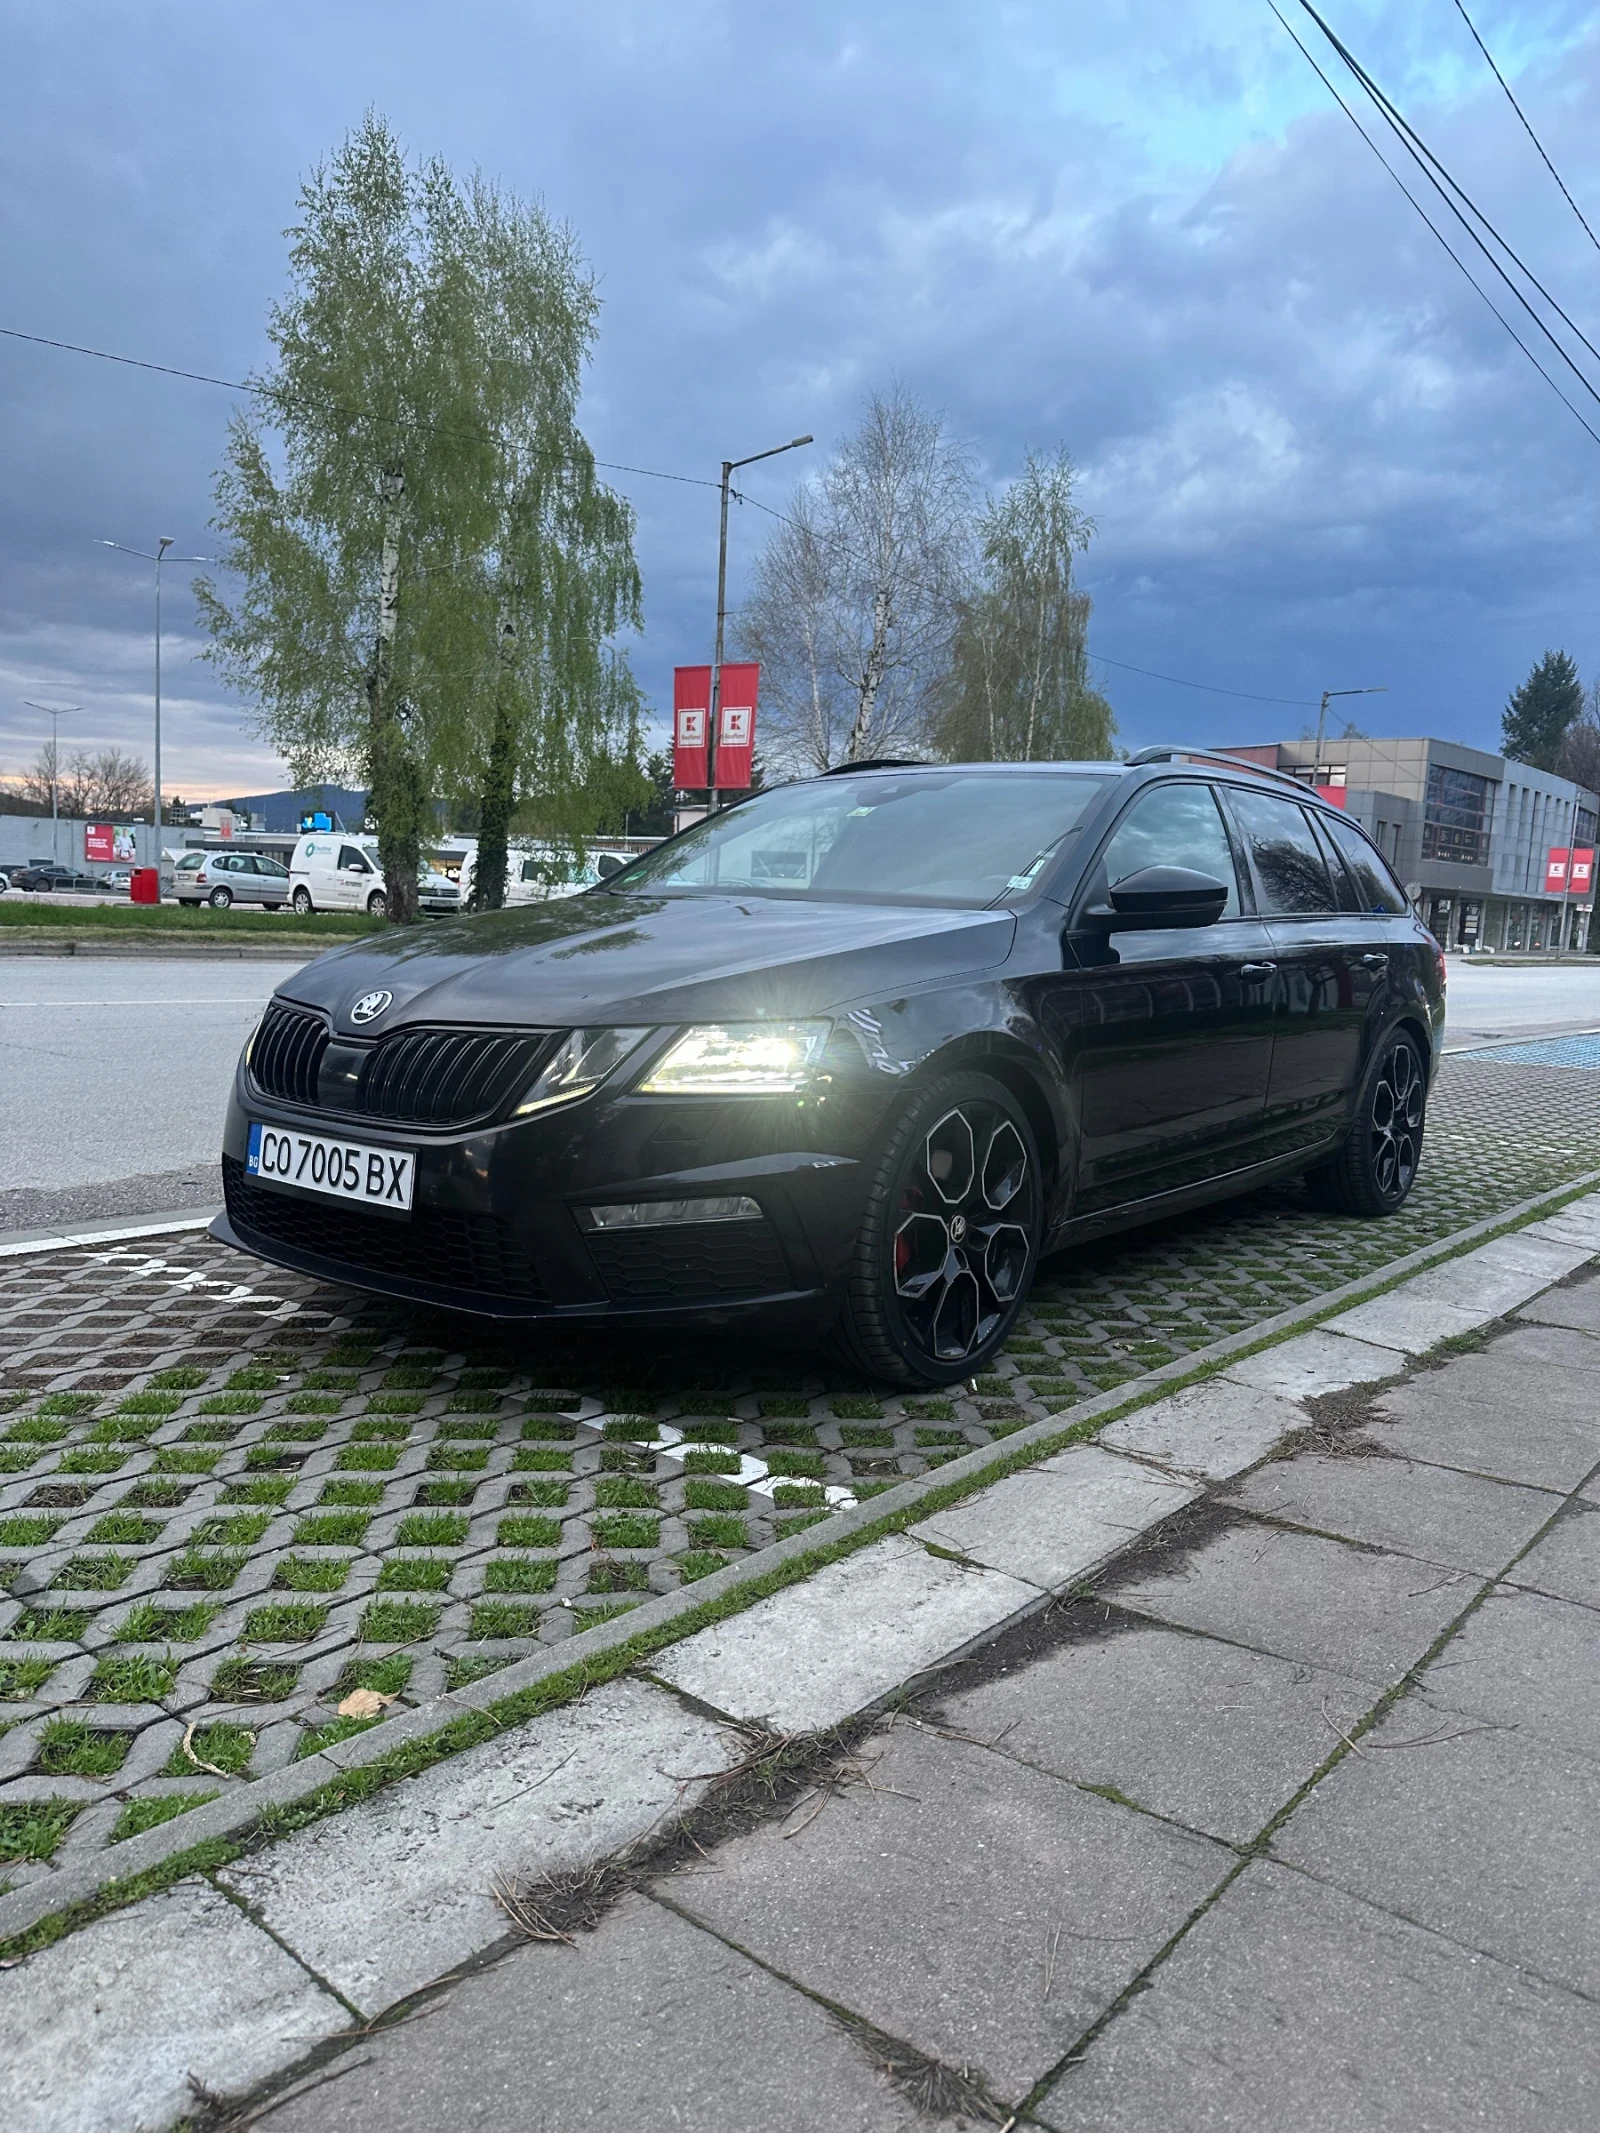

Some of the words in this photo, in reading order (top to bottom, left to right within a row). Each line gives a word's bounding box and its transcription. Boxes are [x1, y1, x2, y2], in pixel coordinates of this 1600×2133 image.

[686, 716, 697, 731] K
[730, 714, 742, 730] K
[248, 1154, 259, 1169] BG
